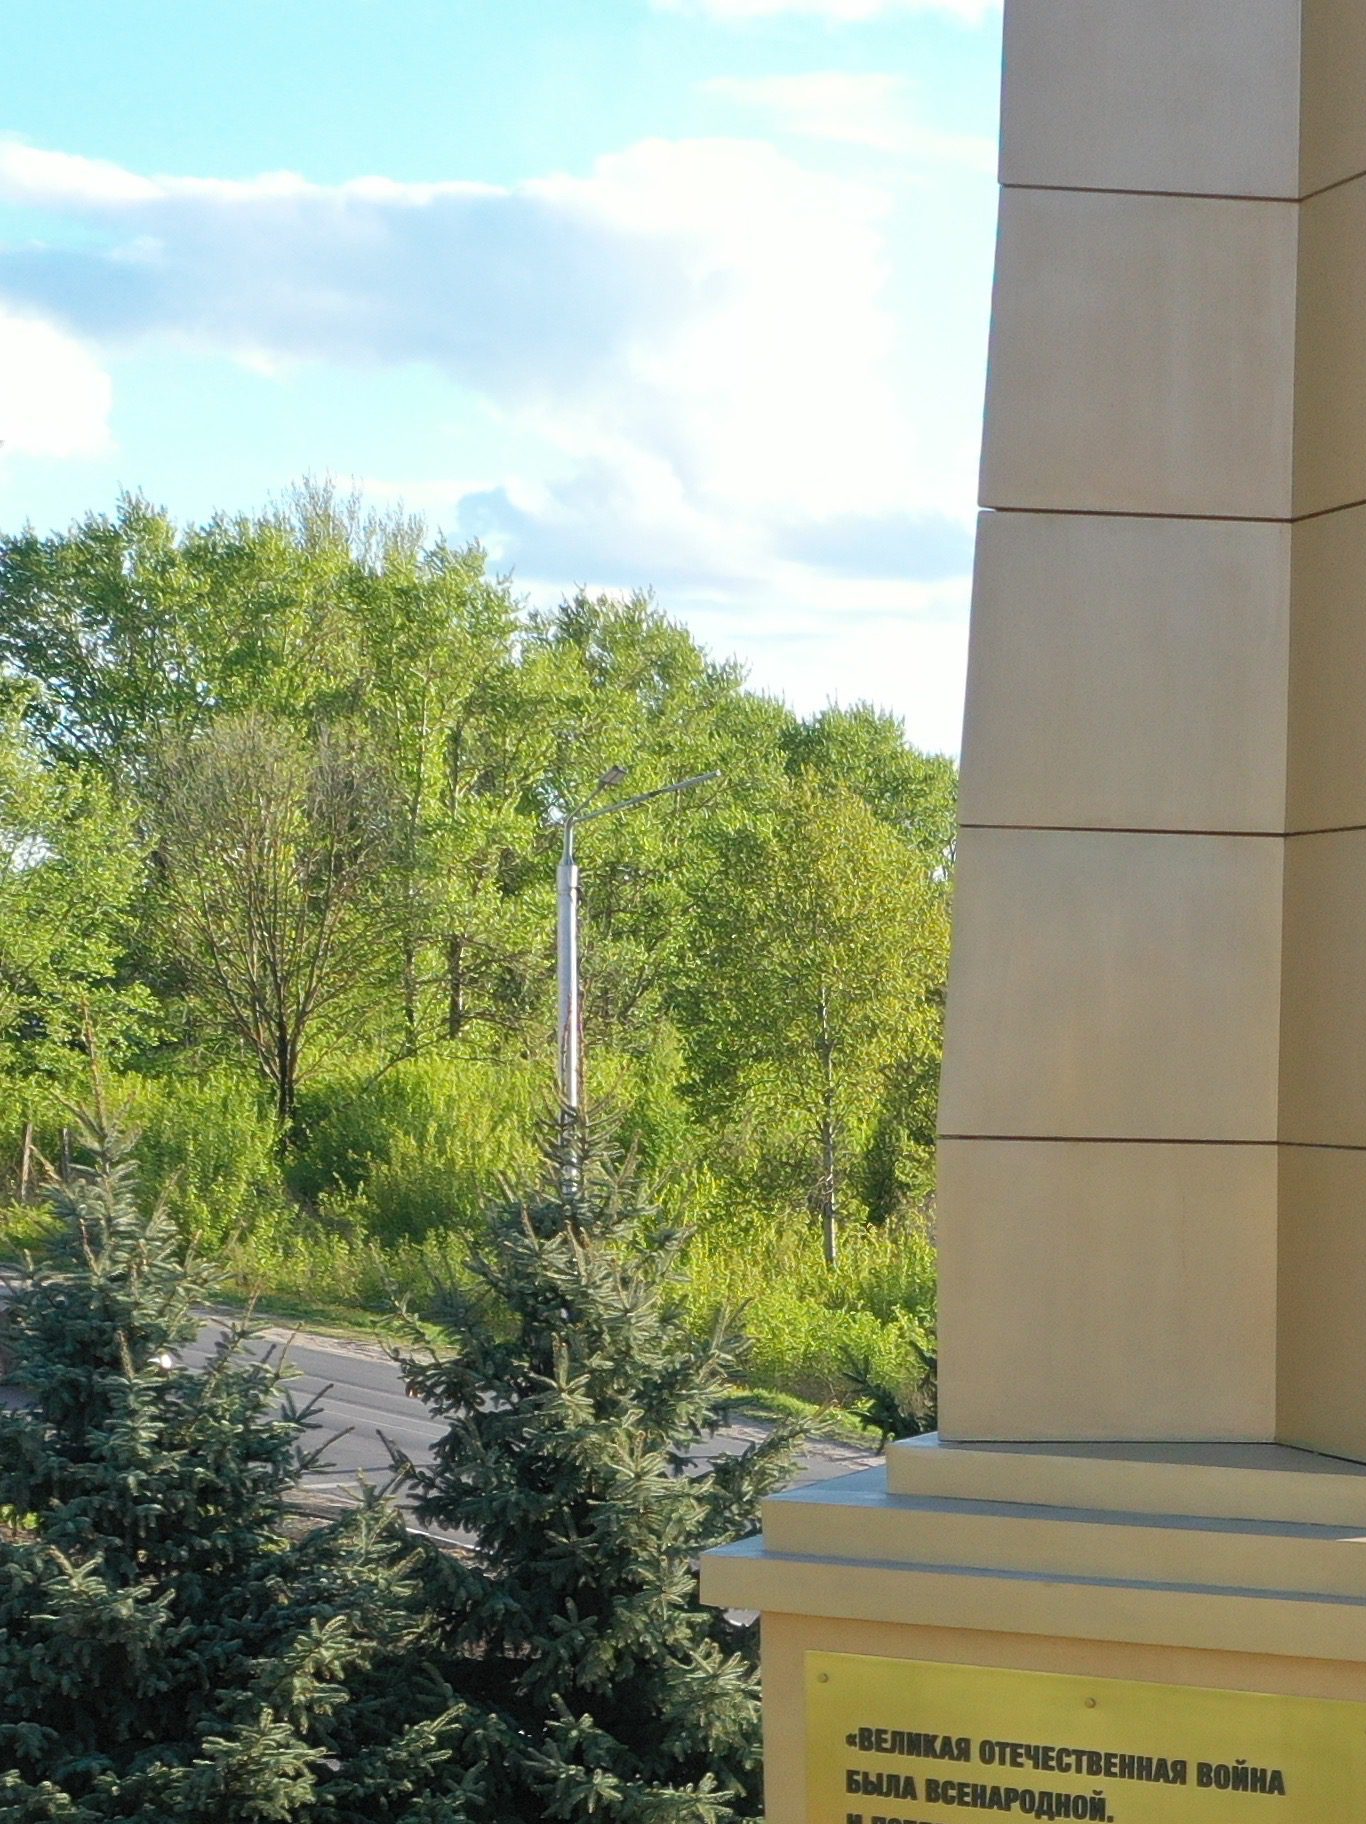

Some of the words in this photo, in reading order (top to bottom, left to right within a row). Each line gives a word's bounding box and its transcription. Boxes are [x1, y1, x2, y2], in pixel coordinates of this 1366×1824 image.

[845, 1727, 970, 1763] «ВЕЛИКАЯ
[978, 1739, 1187, 1786] ОТЕЧЕСТВЕННАЯ
[1196, 1759, 1286, 1796] ВОЙНА
[845, 1769, 917, 1801] БЫЛА
[925, 1778, 1114, 1823] ВСЕНАРОДНОЙ.
